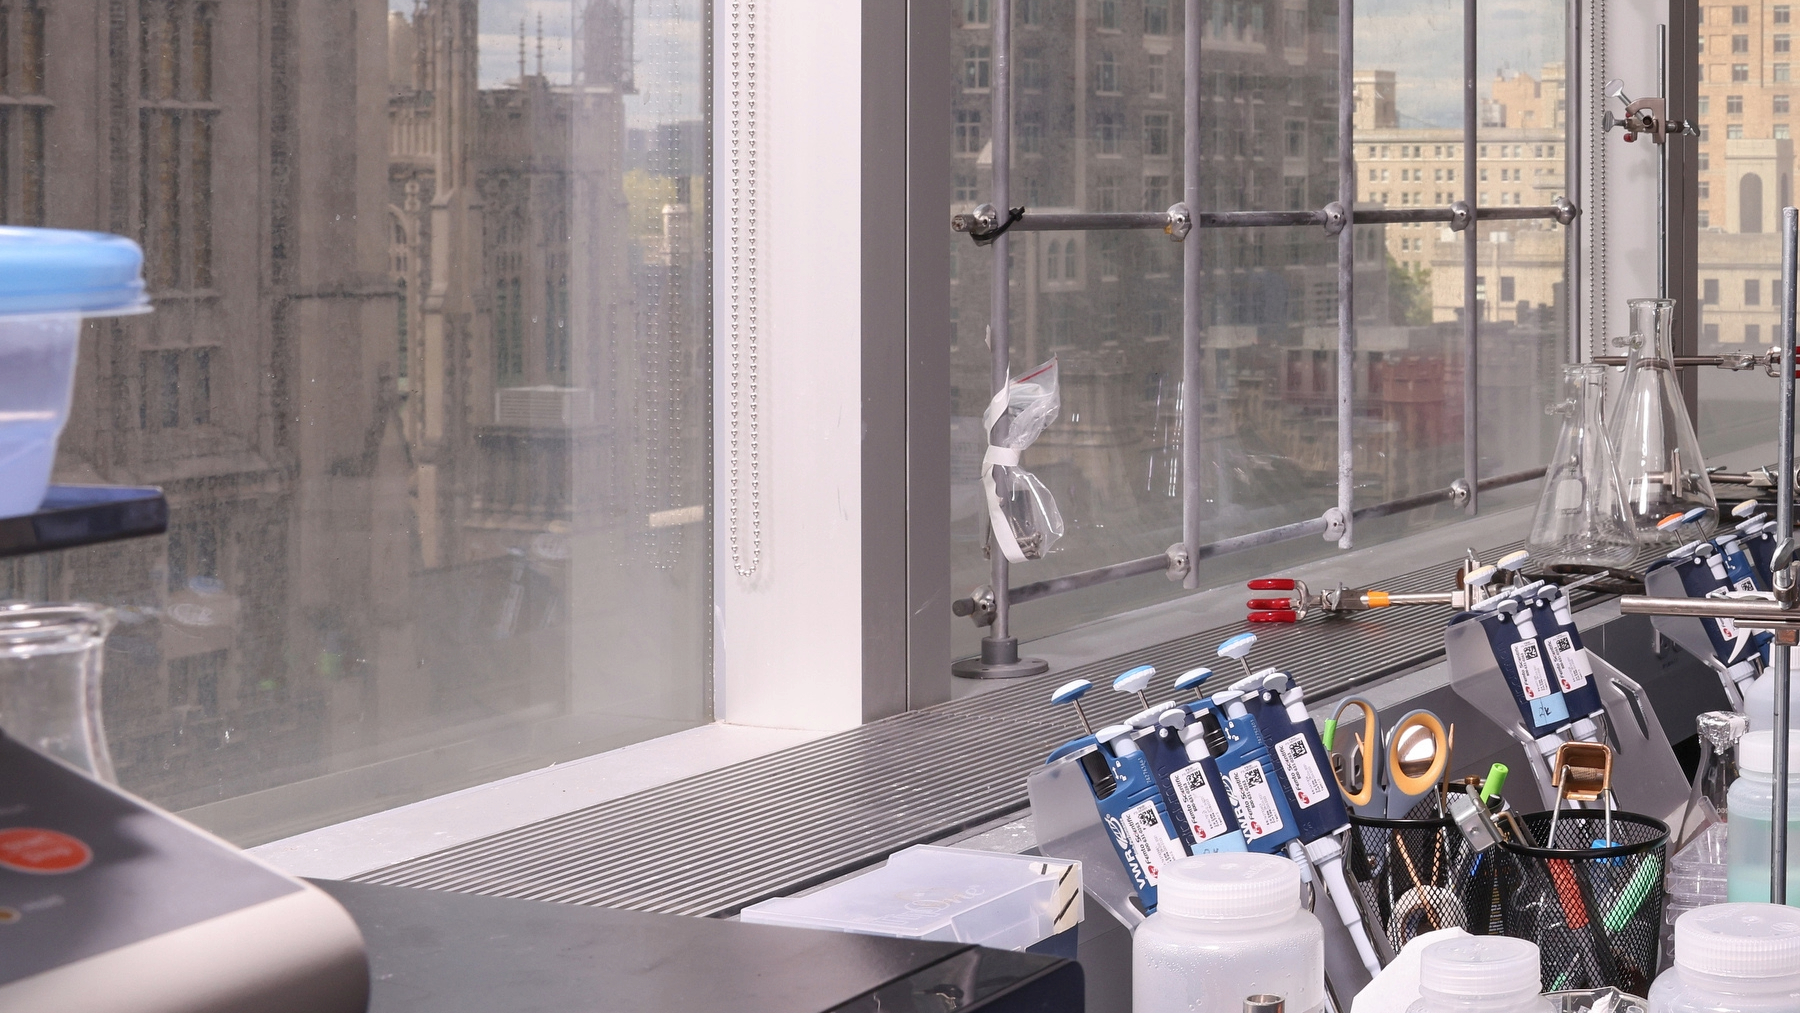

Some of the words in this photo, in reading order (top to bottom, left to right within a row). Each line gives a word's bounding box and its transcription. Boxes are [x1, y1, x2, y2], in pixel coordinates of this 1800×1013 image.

[1278, 745, 1293, 772] Scientific
[1173, 775, 1189, 803] Scientific
[1233, 772, 1247, 800] Scientific
[1290, 772, 1301, 791] Femto
[1185, 804, 1198, 824] Femto
[1243, 800, 1255, 820] Femto
[1125, 814, 1142, 843] Scientific
[1139, 844, 1151, 865] Femto
[1124, 848, 1147, 890] VWR
